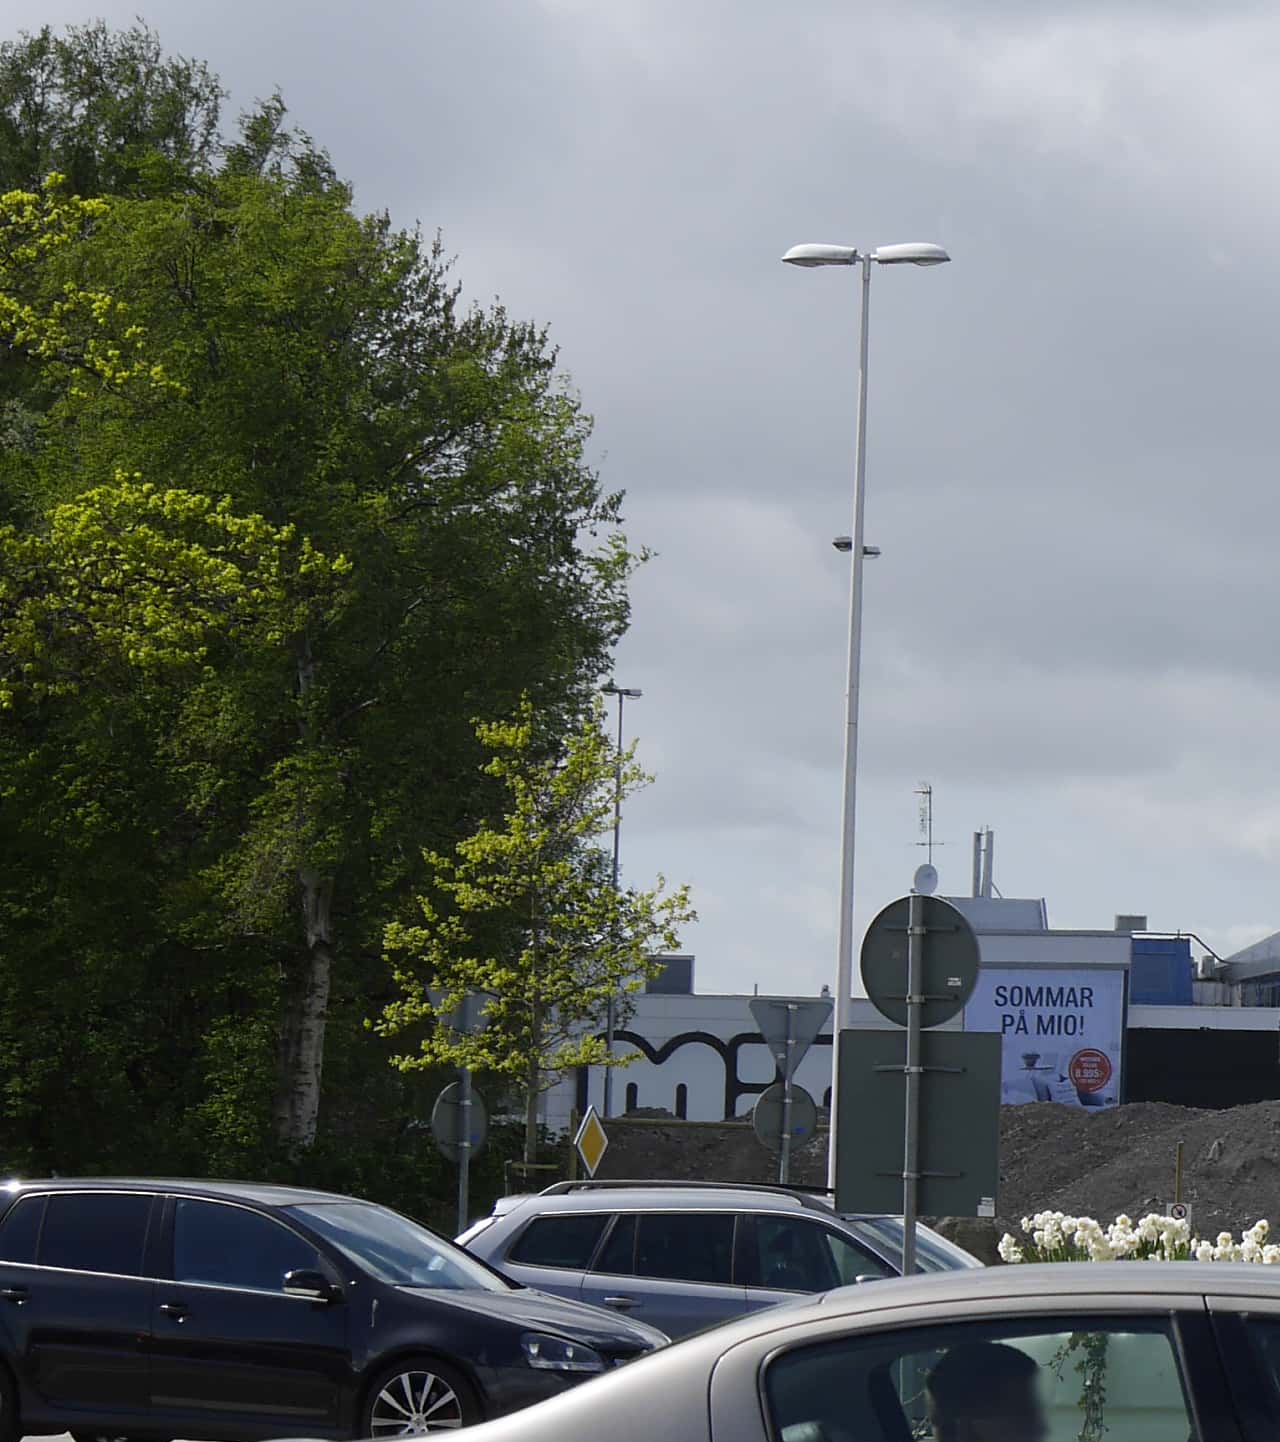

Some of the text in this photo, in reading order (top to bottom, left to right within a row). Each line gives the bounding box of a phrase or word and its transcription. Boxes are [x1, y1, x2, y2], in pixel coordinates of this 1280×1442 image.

[994, 985, 1094, 1008] SOMMAR
[1001, 1009, 1085, 1036] PÅ MIO!
